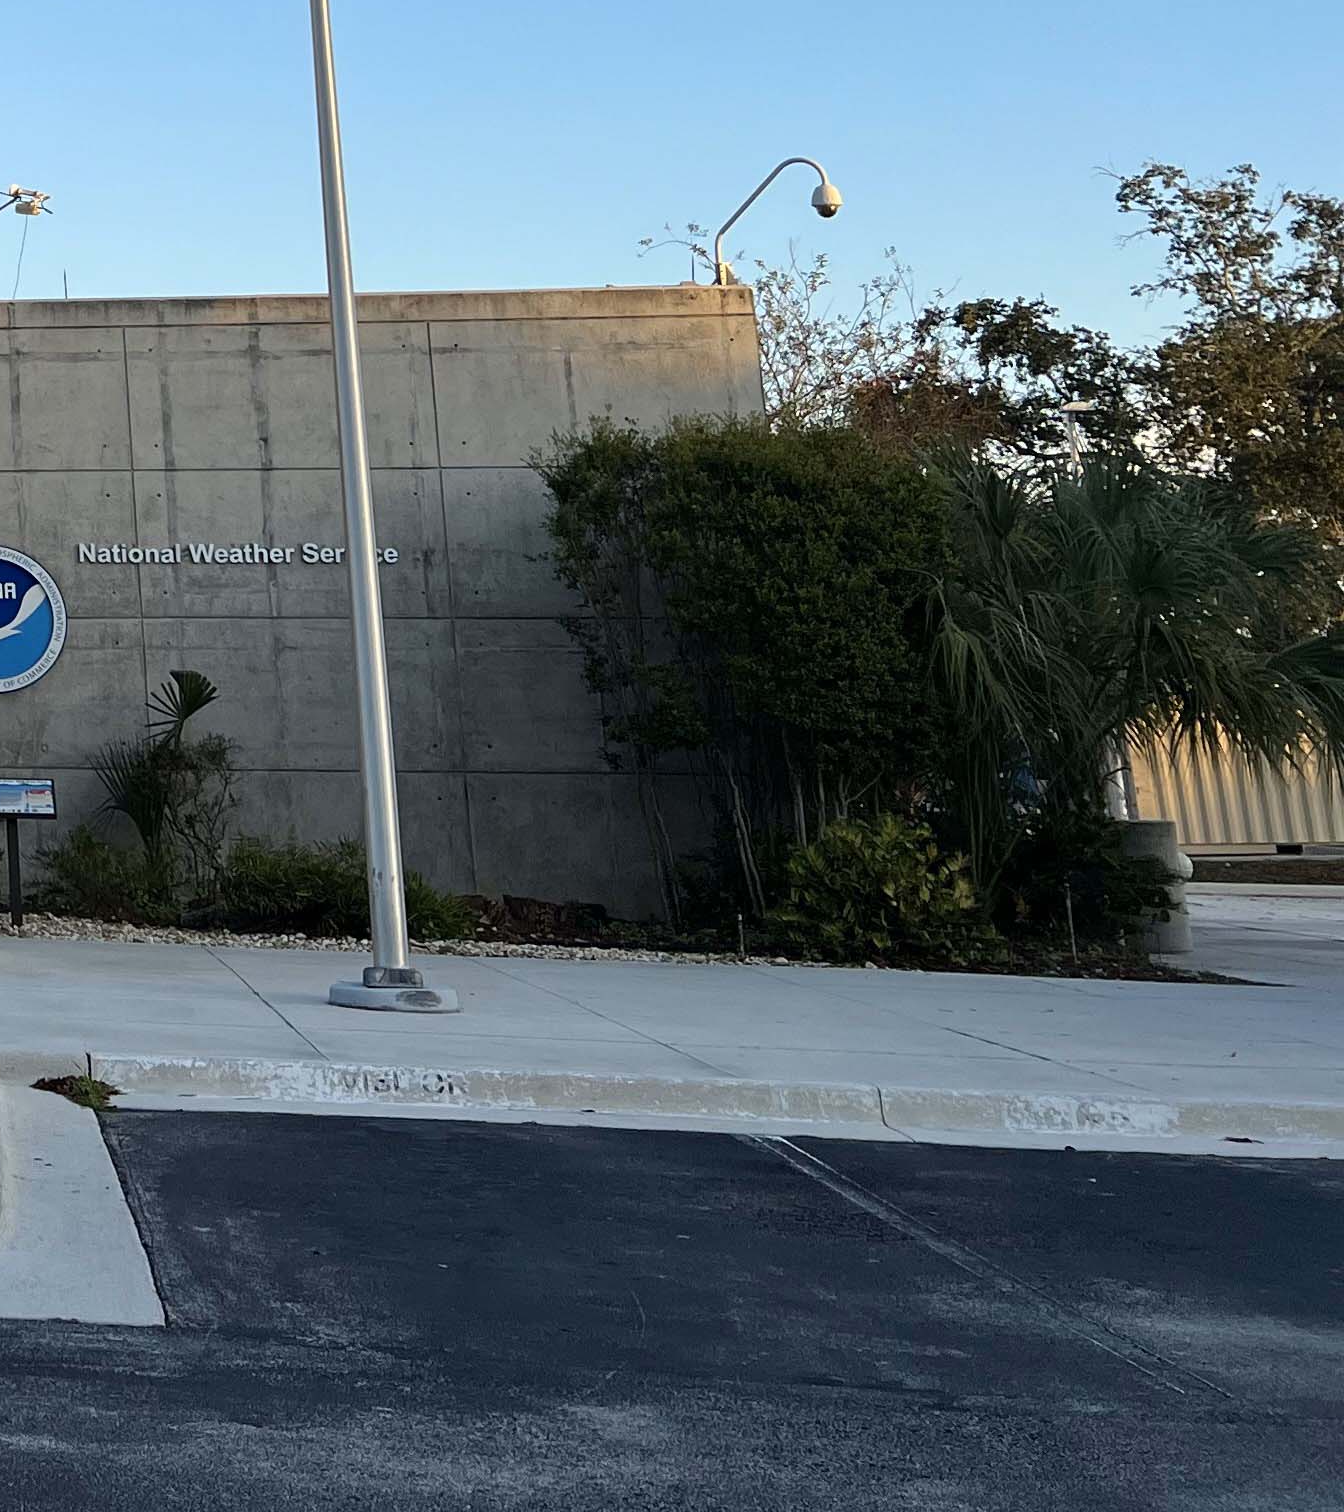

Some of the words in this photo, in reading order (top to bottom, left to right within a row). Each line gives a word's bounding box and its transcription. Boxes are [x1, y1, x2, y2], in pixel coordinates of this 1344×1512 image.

[78, 543, 181, 564] National
[189, 543, 295, 564] Weather
[302, 542, 399, 564] Sere
[36, 571, 64, 642] ADMINISTRATION
[3, 679, 16, 689] OF
[17, 648, 57, 686] COMMERCE
